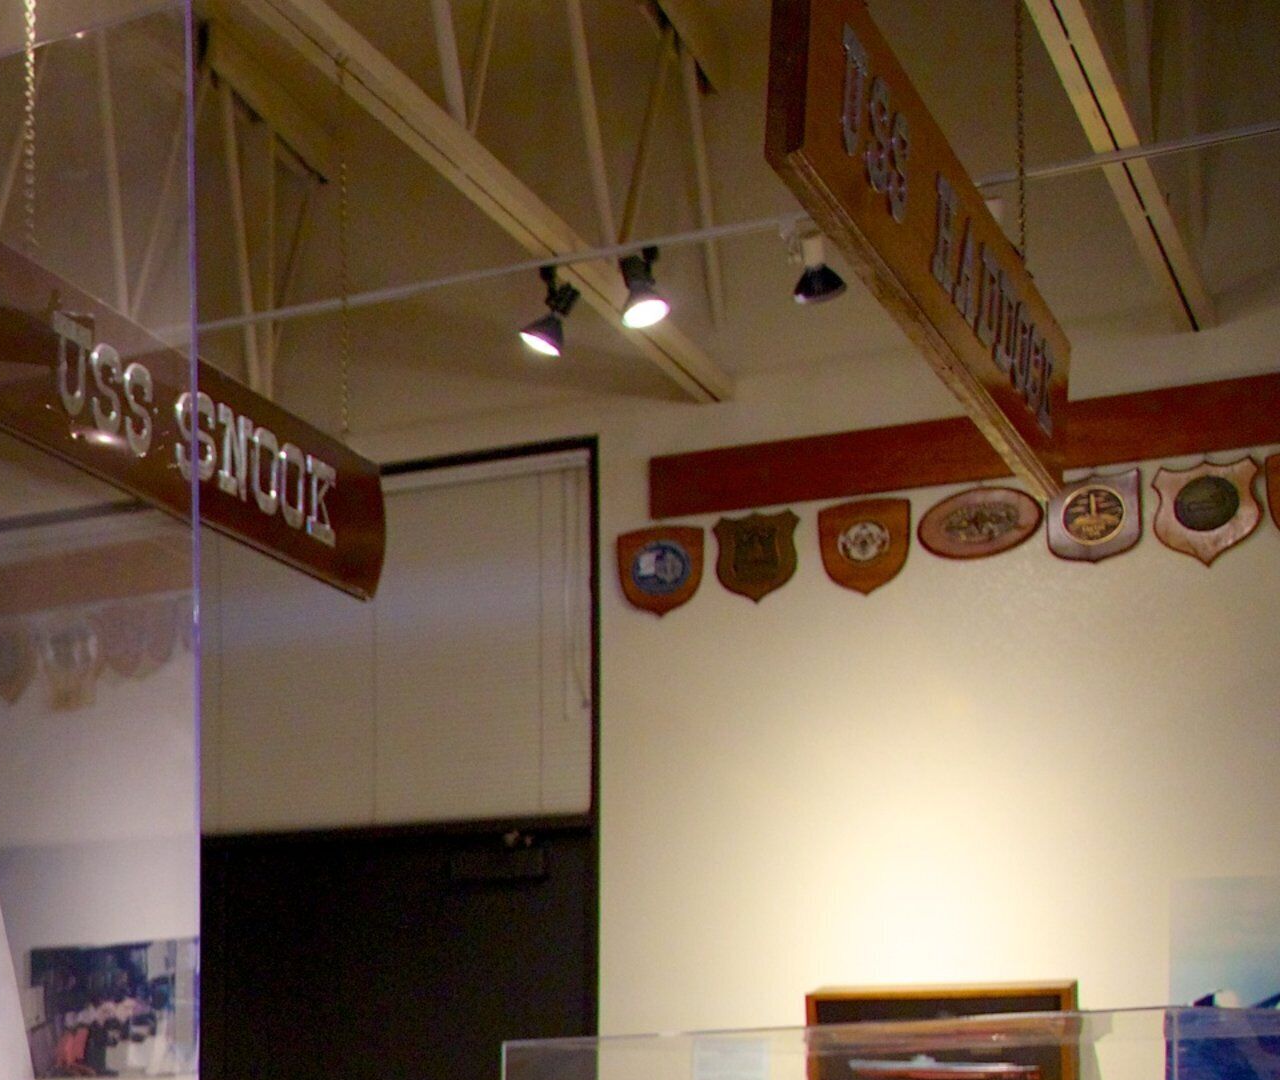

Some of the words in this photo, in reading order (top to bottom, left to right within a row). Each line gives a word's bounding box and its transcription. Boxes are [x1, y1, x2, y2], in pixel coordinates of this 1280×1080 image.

[841, 22, 910, 224] USS
[51, 311, 154, 458] USS
[175, 391, 337, 547] SNOOK
